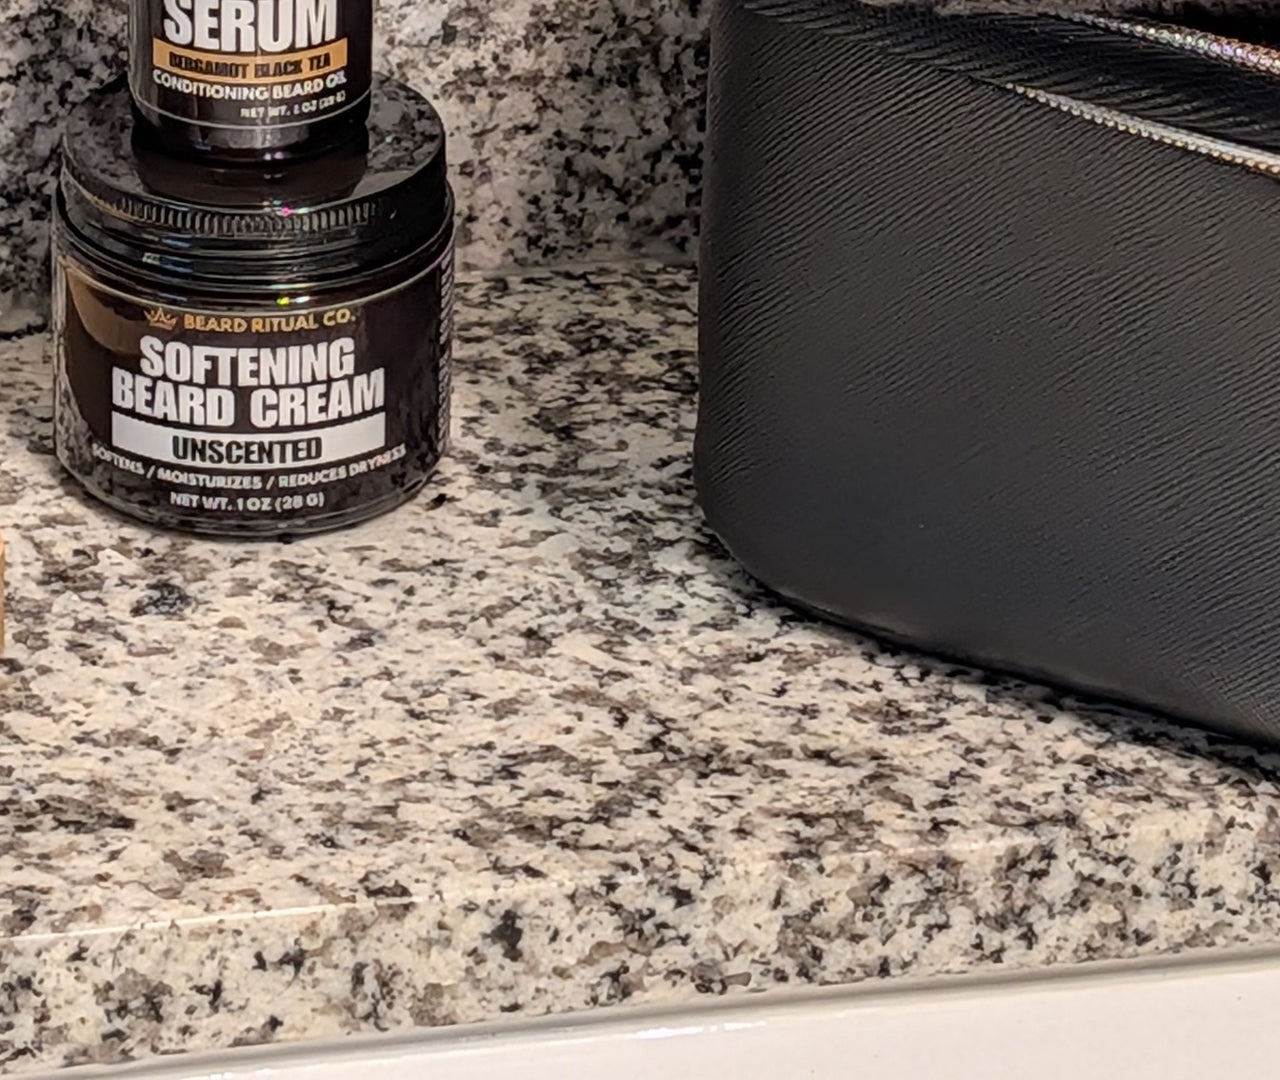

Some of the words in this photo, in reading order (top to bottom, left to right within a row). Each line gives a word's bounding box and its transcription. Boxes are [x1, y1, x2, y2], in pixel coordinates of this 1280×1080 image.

[254, 59, 302, 79] BLACK
[307, 52, 330, 72] TEA
[152, 69, 270, 101] CONDITIONING
[272, 78, 324, 100] BEARD
[326, 70, 347, 88] OIL
[240, 107, 265, 118] NET
[184, 313, 248, 333] BEARD
[251, 314, 319, 333] RITUAL
[322, 308, 356, 327] CO.
[140, 334, 355, 387] SOFTENING
[112, 366, 235, 427] BEARD
[250, 367, 385, 428] CREAM
[172, 436, 322, 465] UNSCENTED
[92, 442, 145, 475] SOFTENS
[157, 467, 262, 489] MOISTURIZES
[278, 465, 347, 487] REDUCES
[349, 443, 407, 477] DRYNESS
[170, 491, 199, 508] NET
[202, 495, 233, 511] WT.
[246, 497, 271, 511] OZ
[274, 495, 303, 512] (28
